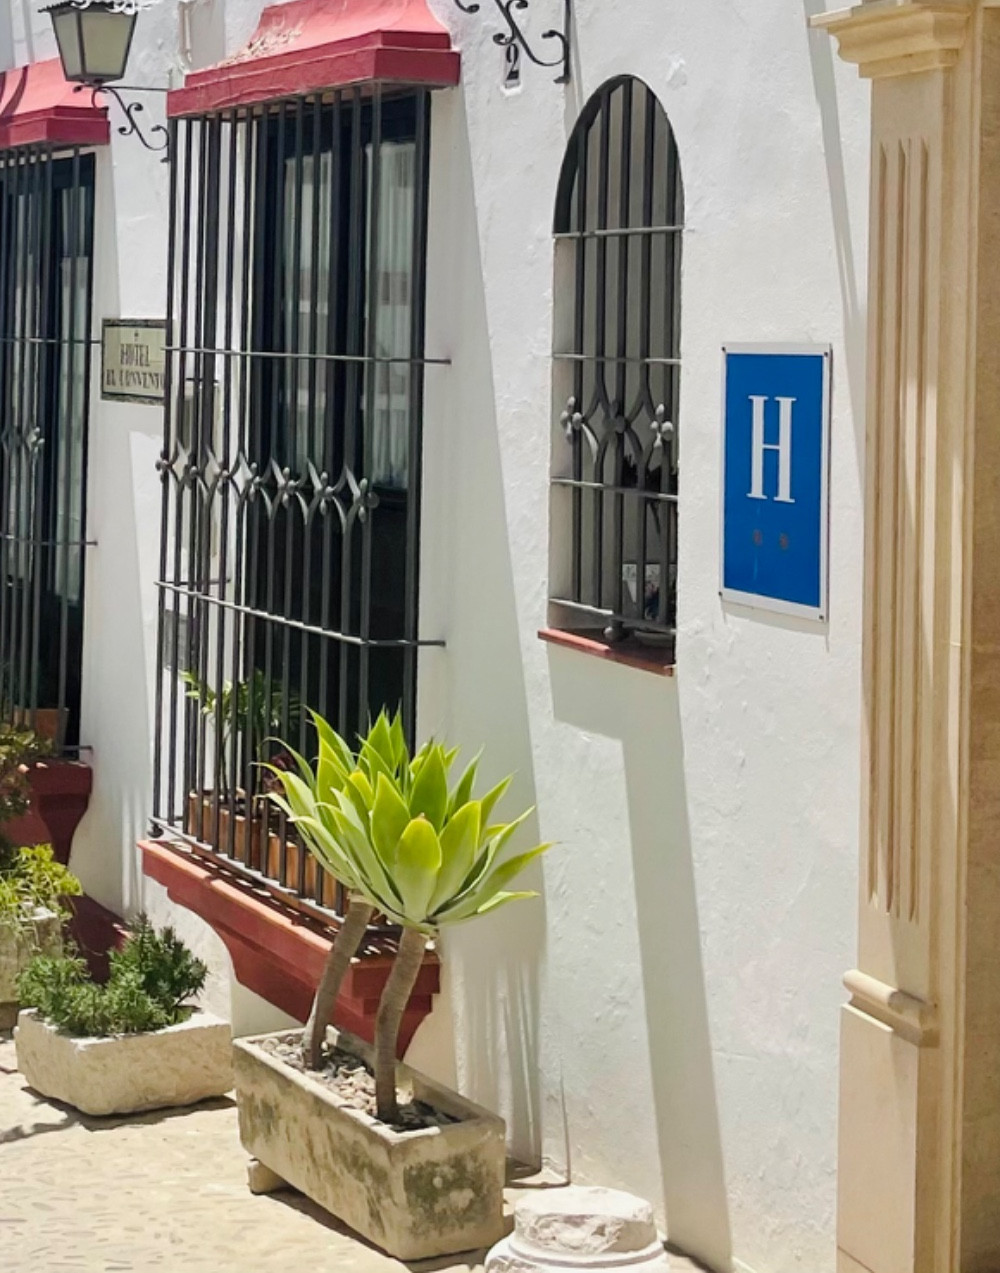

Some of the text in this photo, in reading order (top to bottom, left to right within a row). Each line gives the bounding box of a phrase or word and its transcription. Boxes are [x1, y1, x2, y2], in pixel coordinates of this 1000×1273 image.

[506, 43, 519, 80] 2
[120, 342, 150, 368] HOTEL
[746, 394, 797, 503] H
